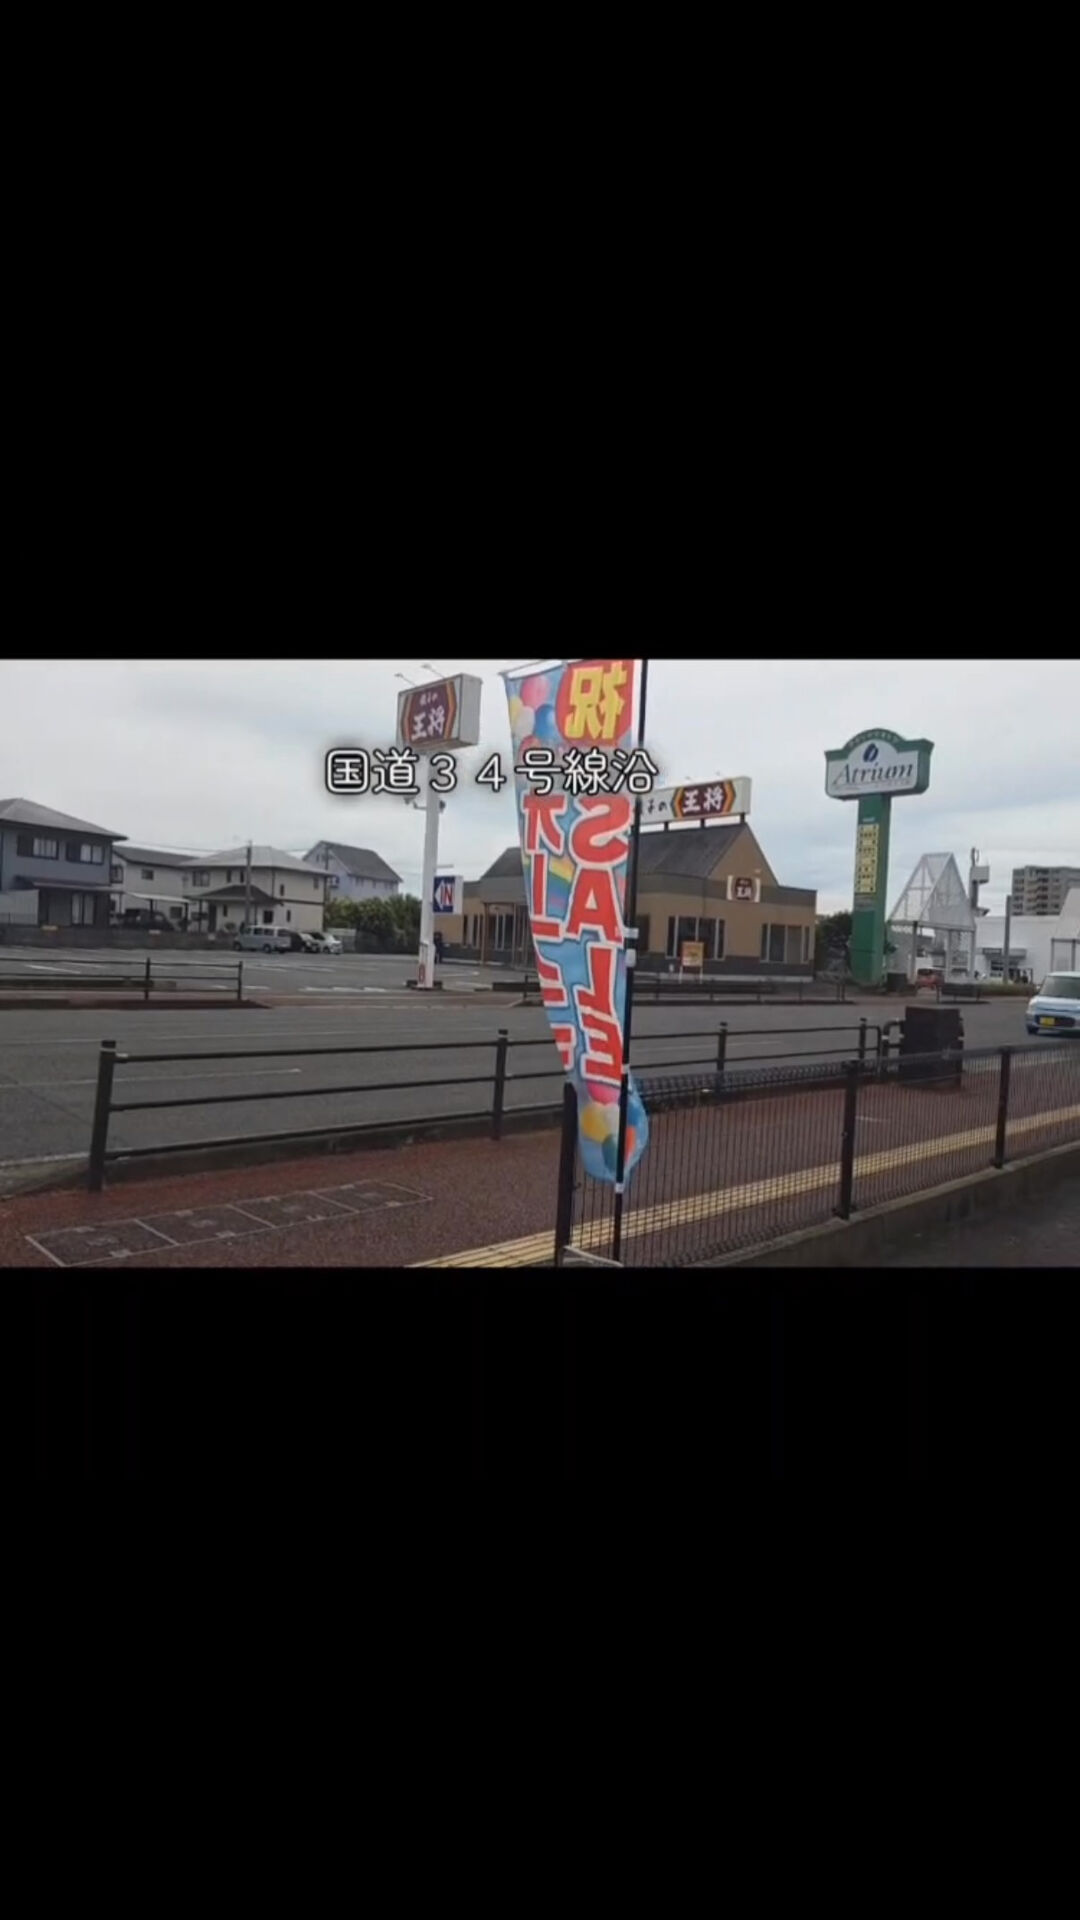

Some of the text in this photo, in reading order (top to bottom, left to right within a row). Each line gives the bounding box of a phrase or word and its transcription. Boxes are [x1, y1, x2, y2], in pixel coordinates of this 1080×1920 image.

[410, 703, 446, 738] 王将
[831, 761, 914, 786] Atrium
[682, 785, 725, 814] 王将
[439, 882, 454, 906] IN
